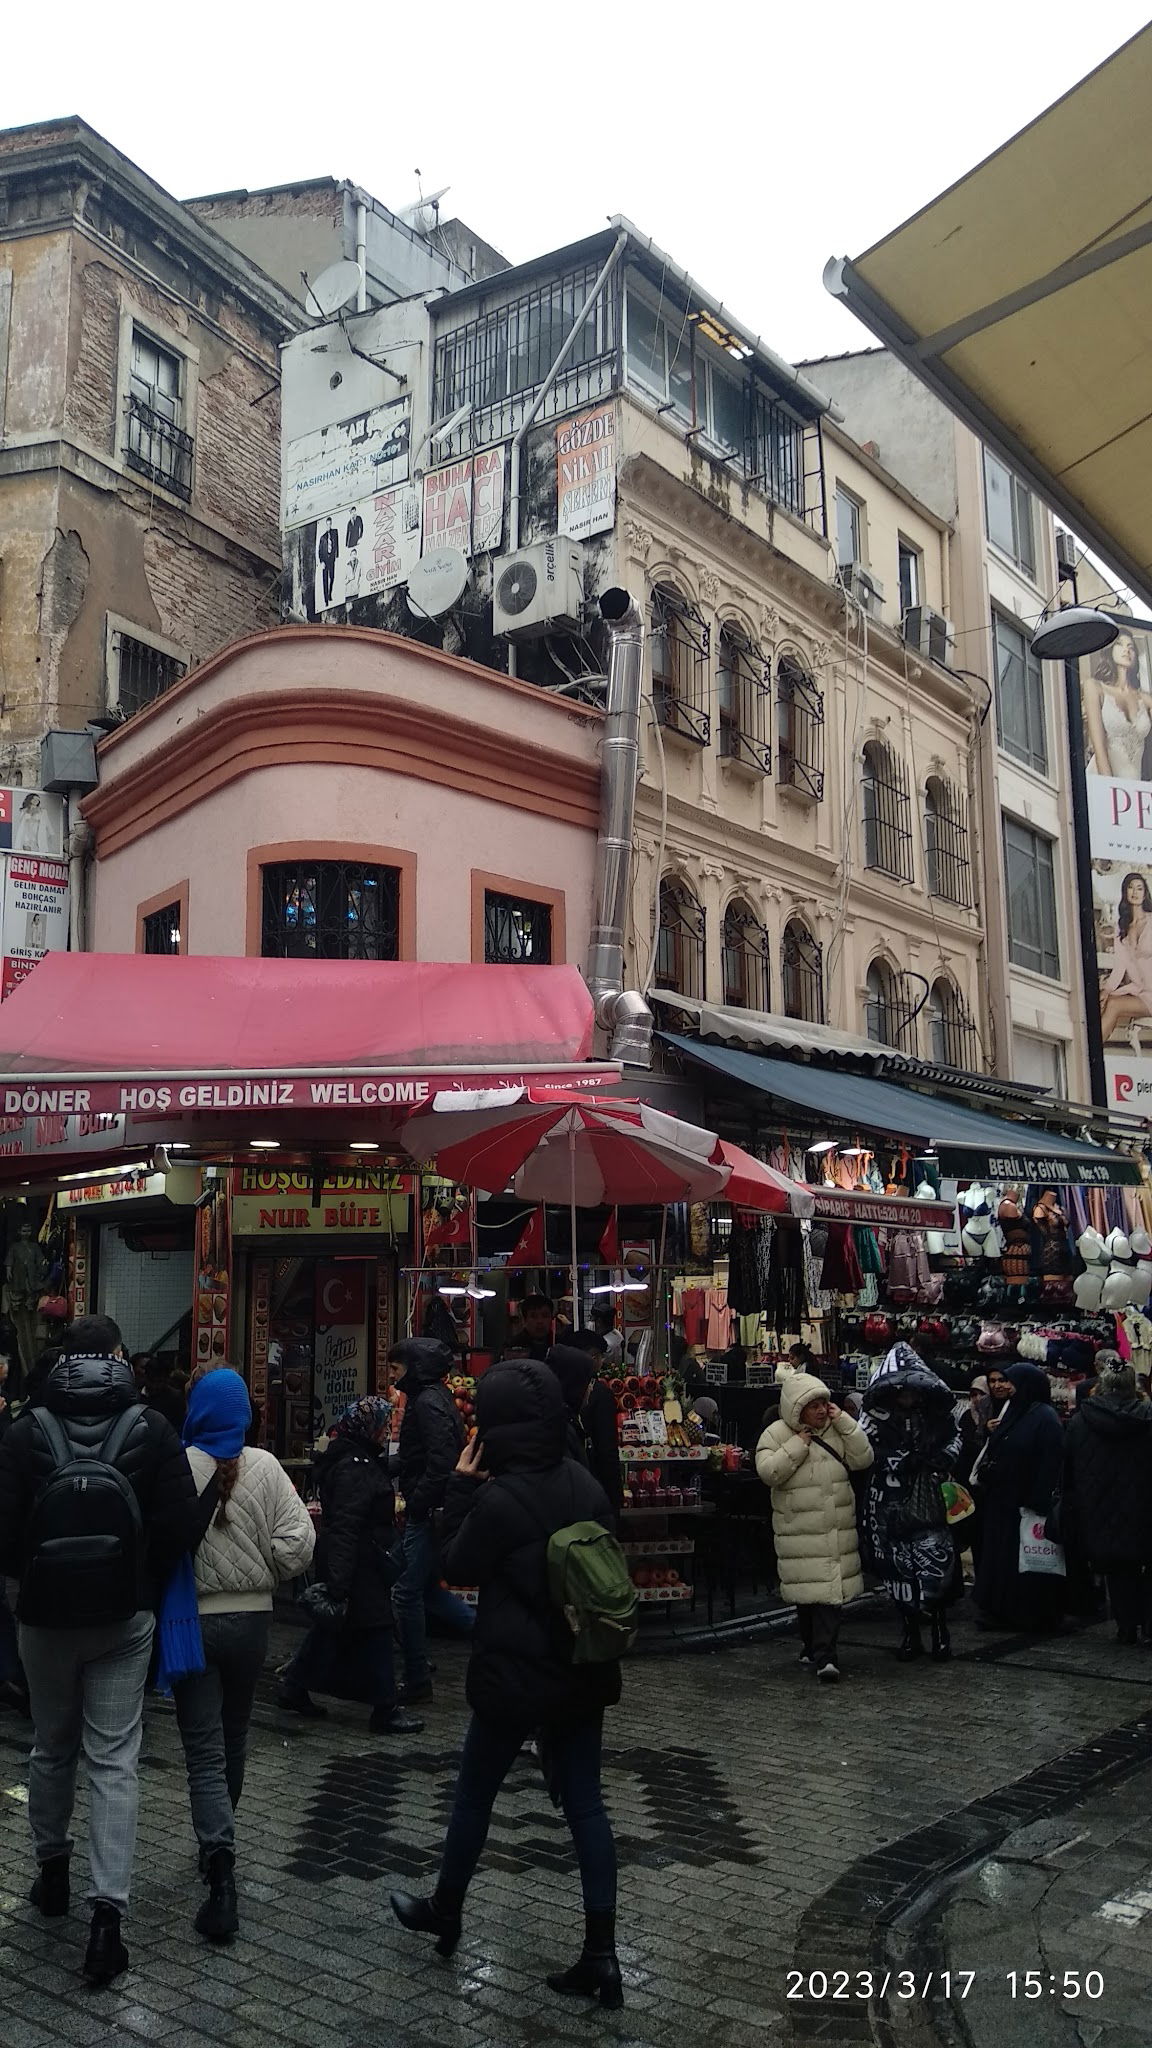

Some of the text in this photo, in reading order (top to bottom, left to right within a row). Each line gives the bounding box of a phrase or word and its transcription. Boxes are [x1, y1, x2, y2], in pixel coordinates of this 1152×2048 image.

[559, 412, 615, 456] GÖZDE
[426, 450, 502, 498] BUHARA
[562, 445, 612, 487] NİKAH
[425, 470, 503, 537] HACI
[562, 473, 612, 524] ŞEKERİ
[569, 511, 609, 533] NASIR HAN
[366, 559, 402, 582] GİYİM
[546, 542, 556, 582] arçelik
[11, 857, 69, 881] GENÇ MODA
[22, 892, 57, 904] BOHÇASI
[38, 885, 66, 896] DAMAT
[15, 901, 62, 915] HAZIRLANIR
[10, 947, 32, 958] GİRİŞ
[5, 1086, 91, 1113] DÖNER
[120, 1087, 172, 1113] HOŞ
[179, 1081, 294, 1107] GELDİNİZ
[310, 1082, 430, 1104] WELCOME
[576, 1078, 602, 1088] 1987
[988, 1155, 1024, 1177] BERİL
[1023, 1156, 1038, 1181] İÇ
[1037, 1158, 1070, 1179] GİYİM
[259, 1202, 382, 1228] NUR BÜFE
[326, 1379, 355, 1395] dolu
